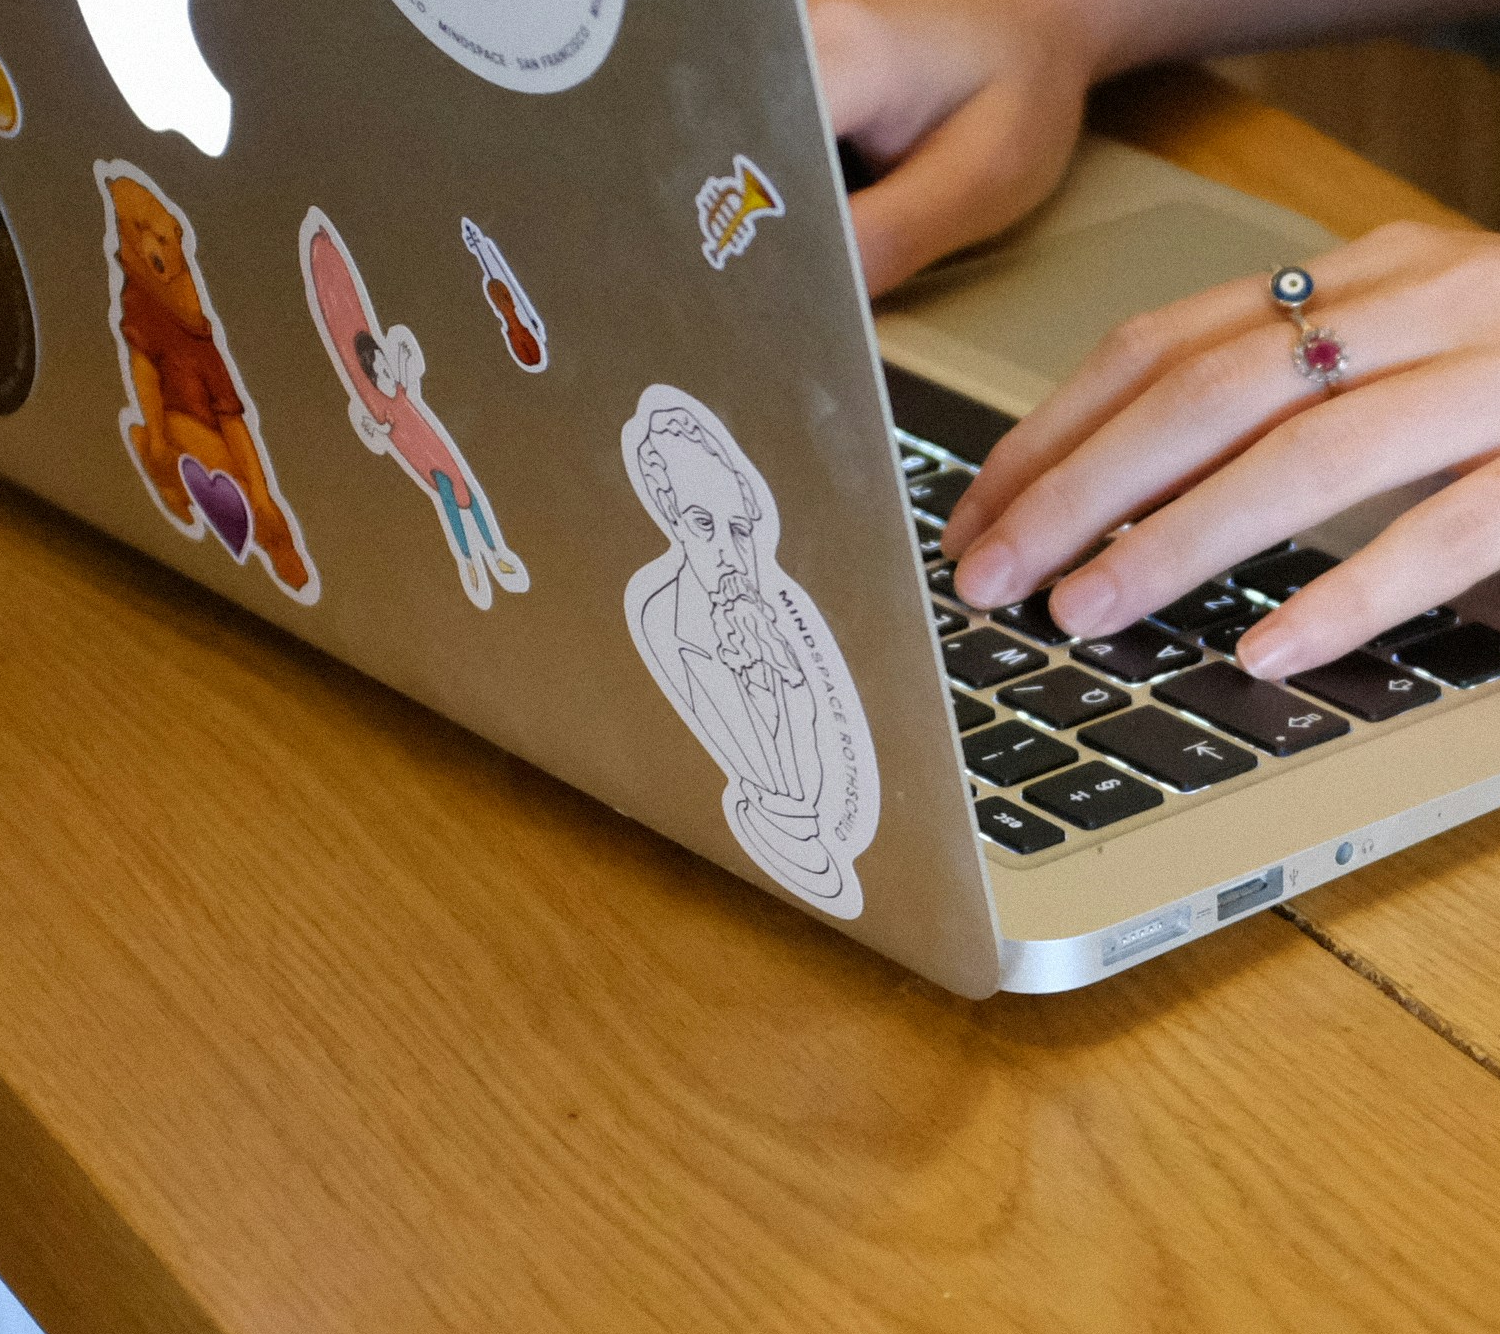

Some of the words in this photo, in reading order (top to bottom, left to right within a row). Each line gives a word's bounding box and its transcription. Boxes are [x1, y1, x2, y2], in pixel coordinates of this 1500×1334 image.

[1204, 595, 1235, 611] Z
[992, 648, 1029, 665] W
[1156, 644, 1187, 660] A
[1081, 688, 1110, 704] Q
[777, 589, 849, 725] MINDSPACE
[833, 731, 860, 843] ROTHSCHILD
[1012, 738, 1037, 751] 1
[981, 752, 1006, 762] !
[993, 812, 1025, 830] esc
